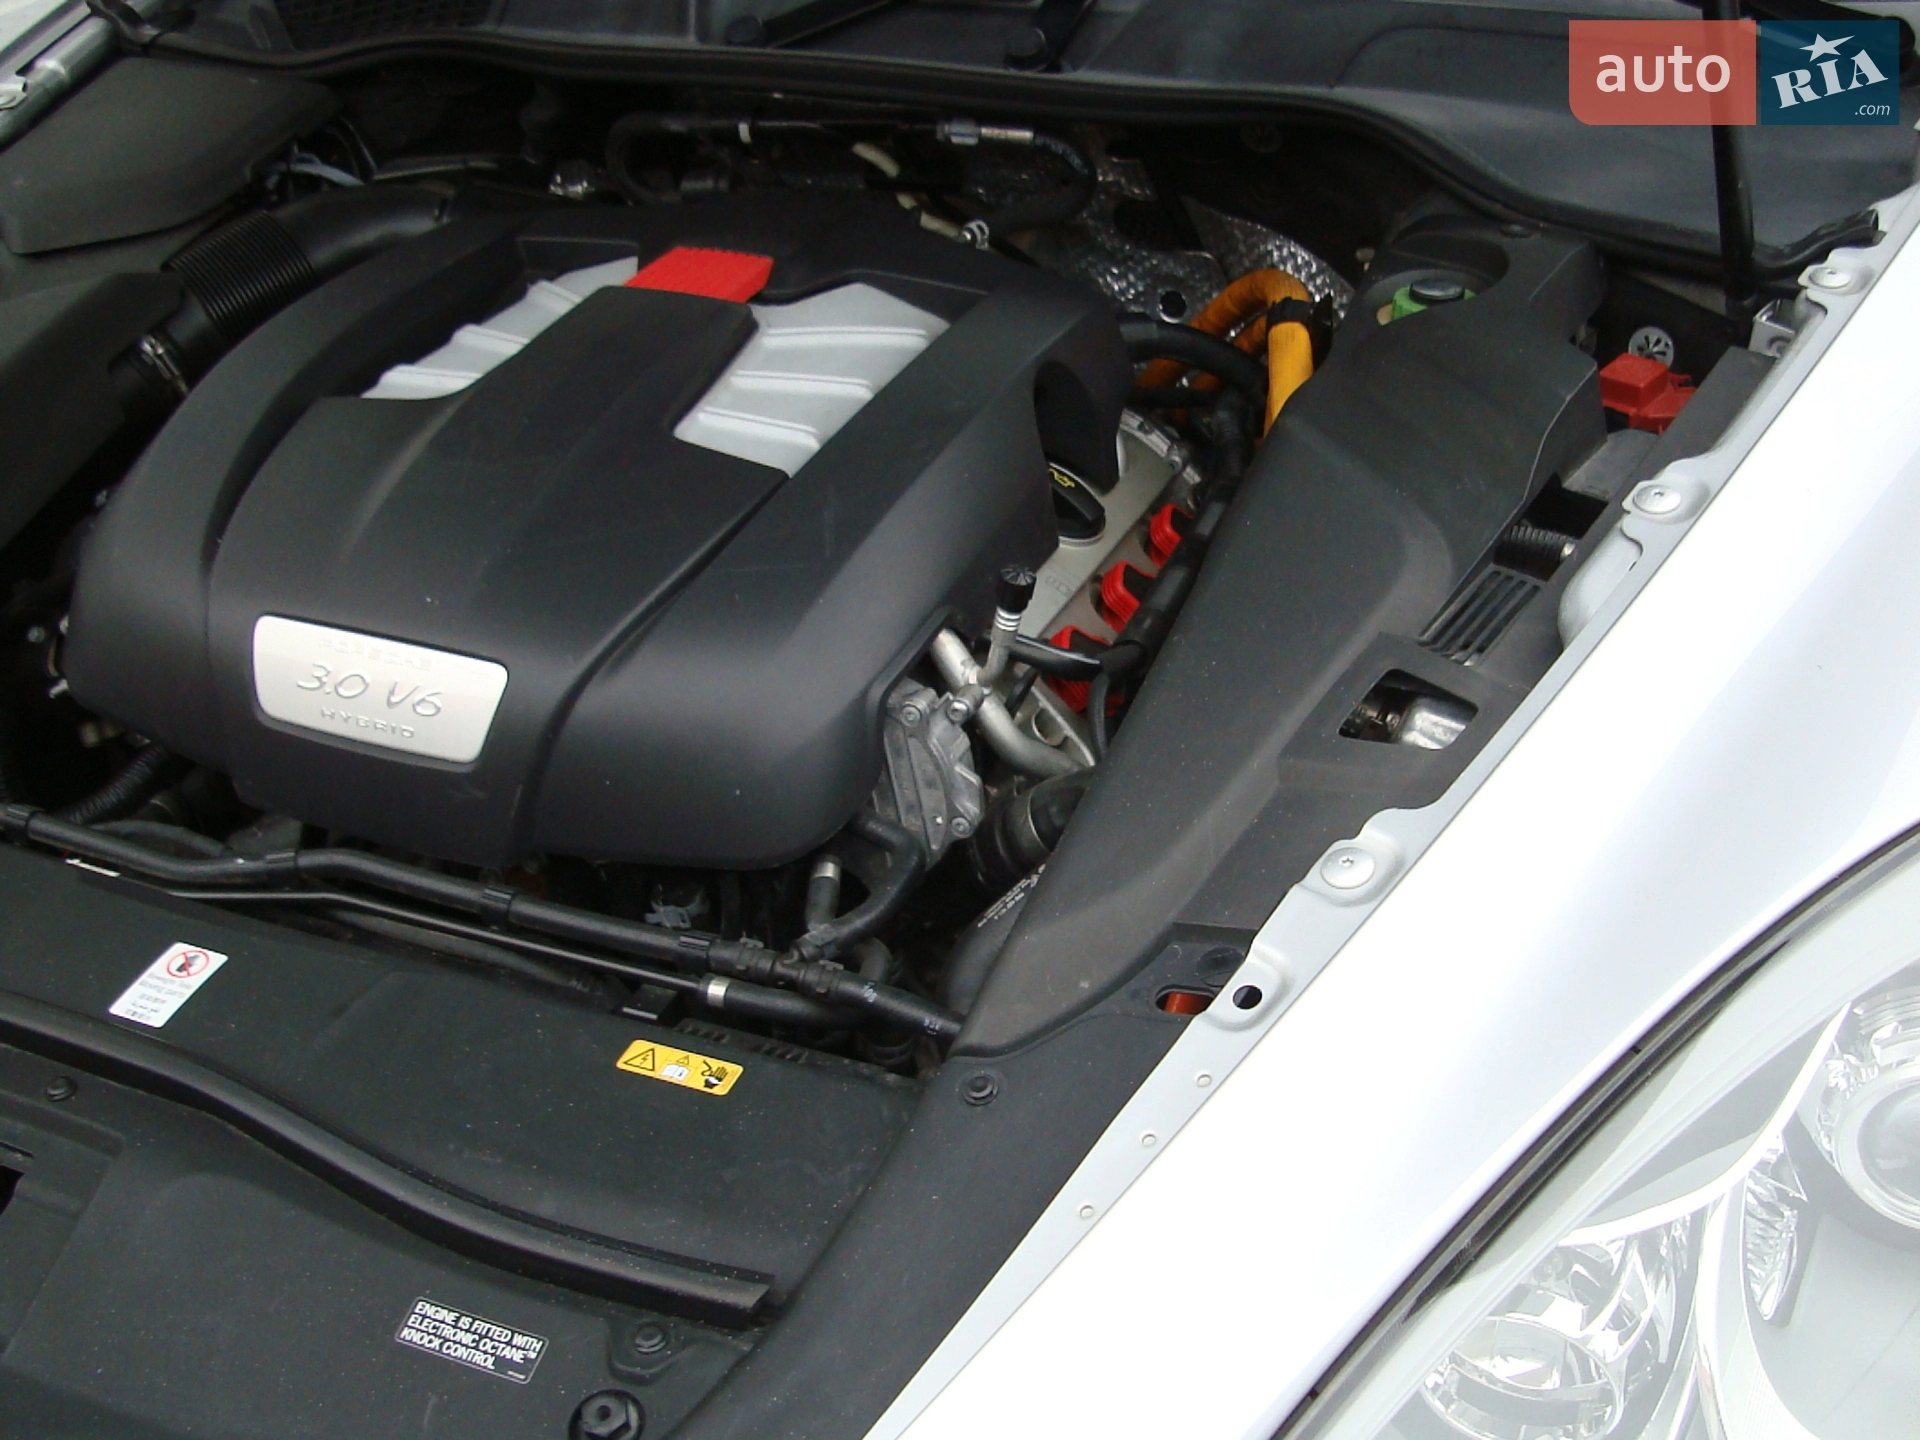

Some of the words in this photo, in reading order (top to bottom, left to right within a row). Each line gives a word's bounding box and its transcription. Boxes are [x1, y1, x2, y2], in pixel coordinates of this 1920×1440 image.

[297, 663, 370, 699] 3.0
[386, 681, 445, 717] V6
[320, 706, 416, 738] HYBRID
[407, 1314, 479, 1348] ELECTRONIC
[414, 1301, 460, 1325] ENGINE
[458, 1315, 473, 1330] IS
[470, 1319, 512, 1343] FITTED
[512, 1332, 543, 1352] WITH
[400, 1327, 445, 1351] KNOCK
[442, 1341, 496, 1370] CONTROL
